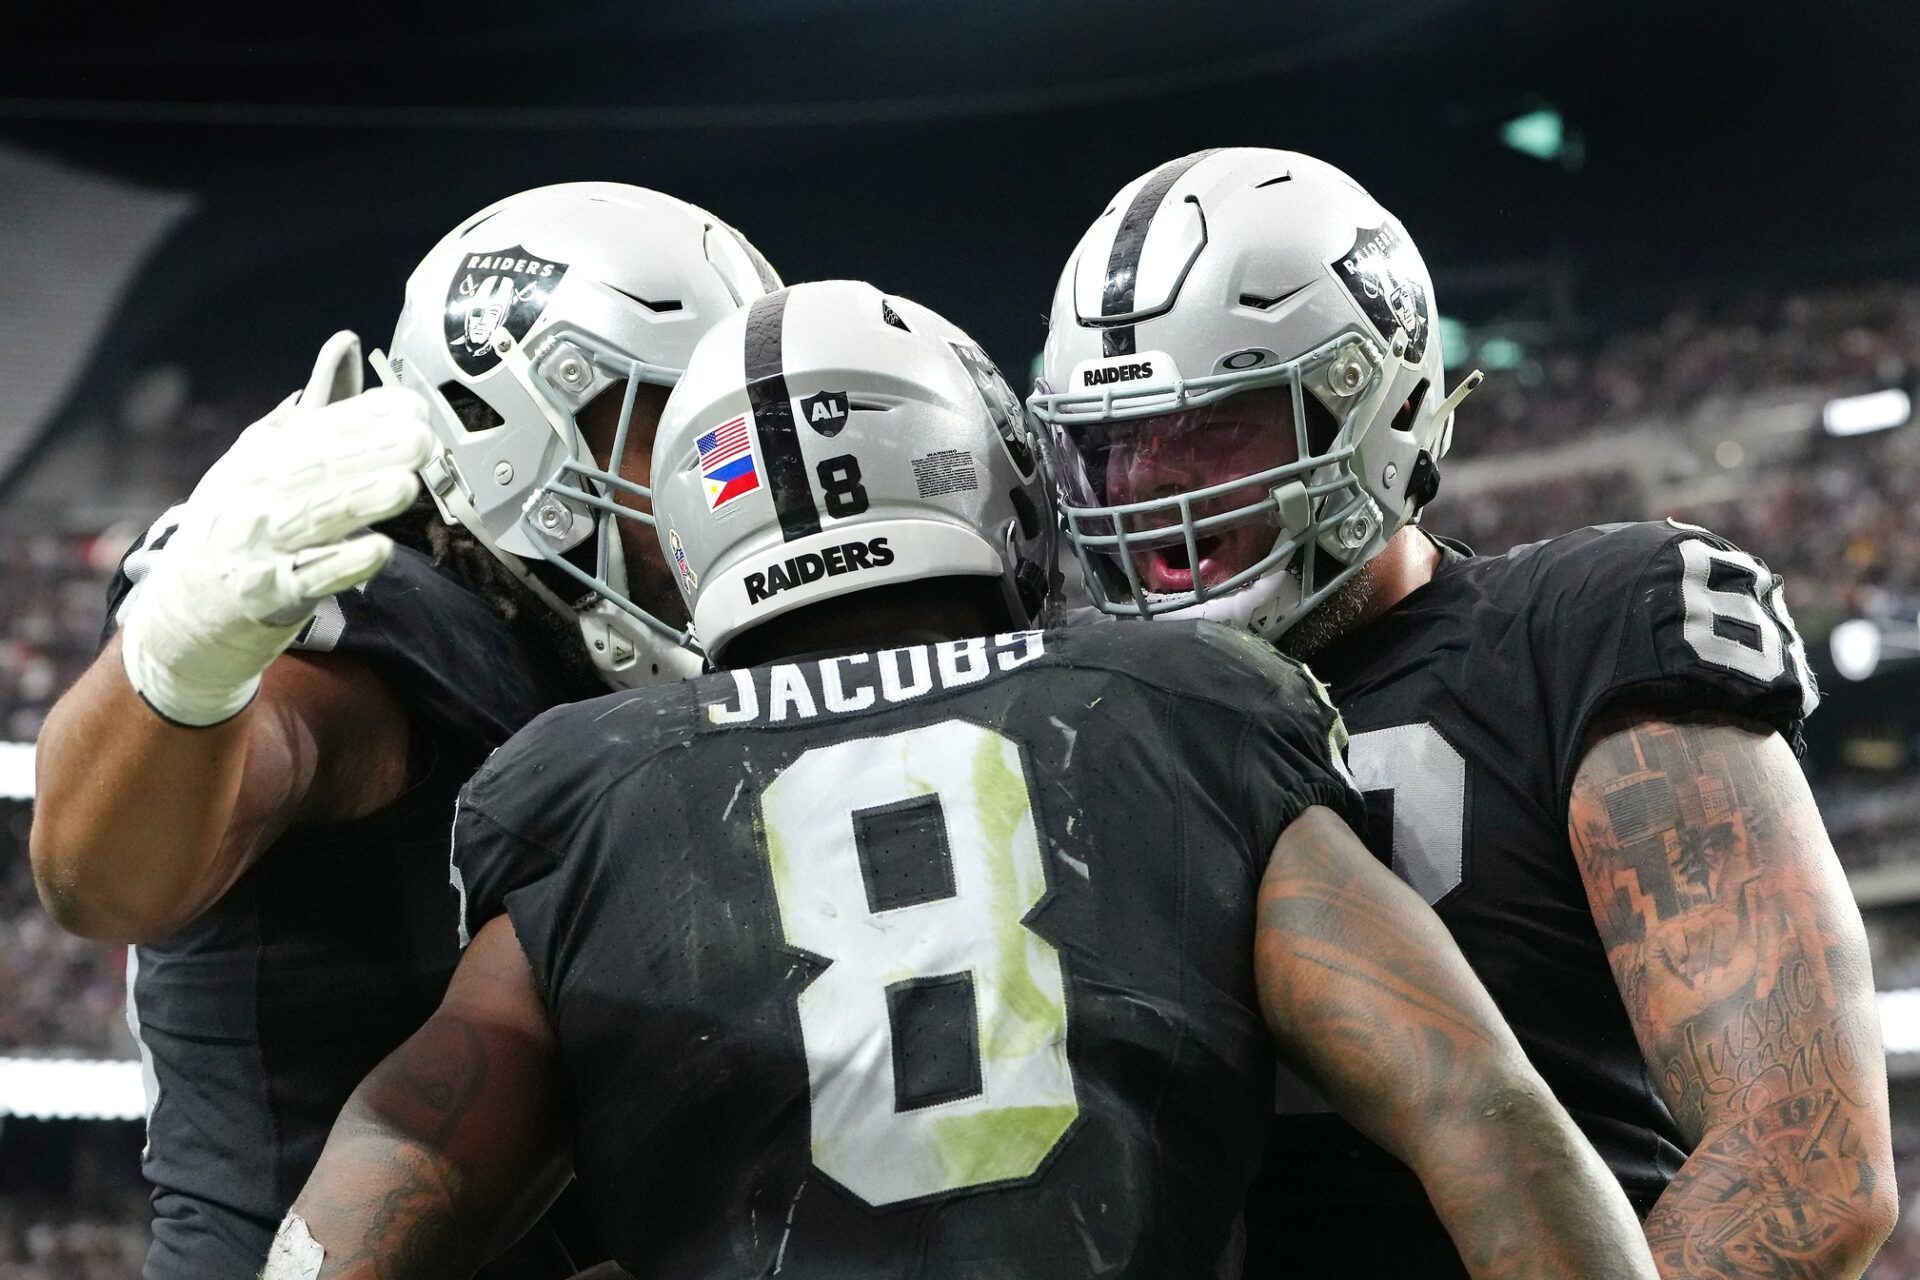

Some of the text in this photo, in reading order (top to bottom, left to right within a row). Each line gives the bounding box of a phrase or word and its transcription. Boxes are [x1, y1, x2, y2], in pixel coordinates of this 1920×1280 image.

[467, 256, 555, 277] RAIDERS
[1083, 362, 1153, 386] RAIDERS
[811, 400, 845, 421] AL
[926, 449, 958, 457] WARNING
[816, 454, 869, 519] 8
[743, 537, 895, 605] RAIDERS
[708, 629, 1046, 725] JACOBS
[761, 719, 1078, 1207] 8
